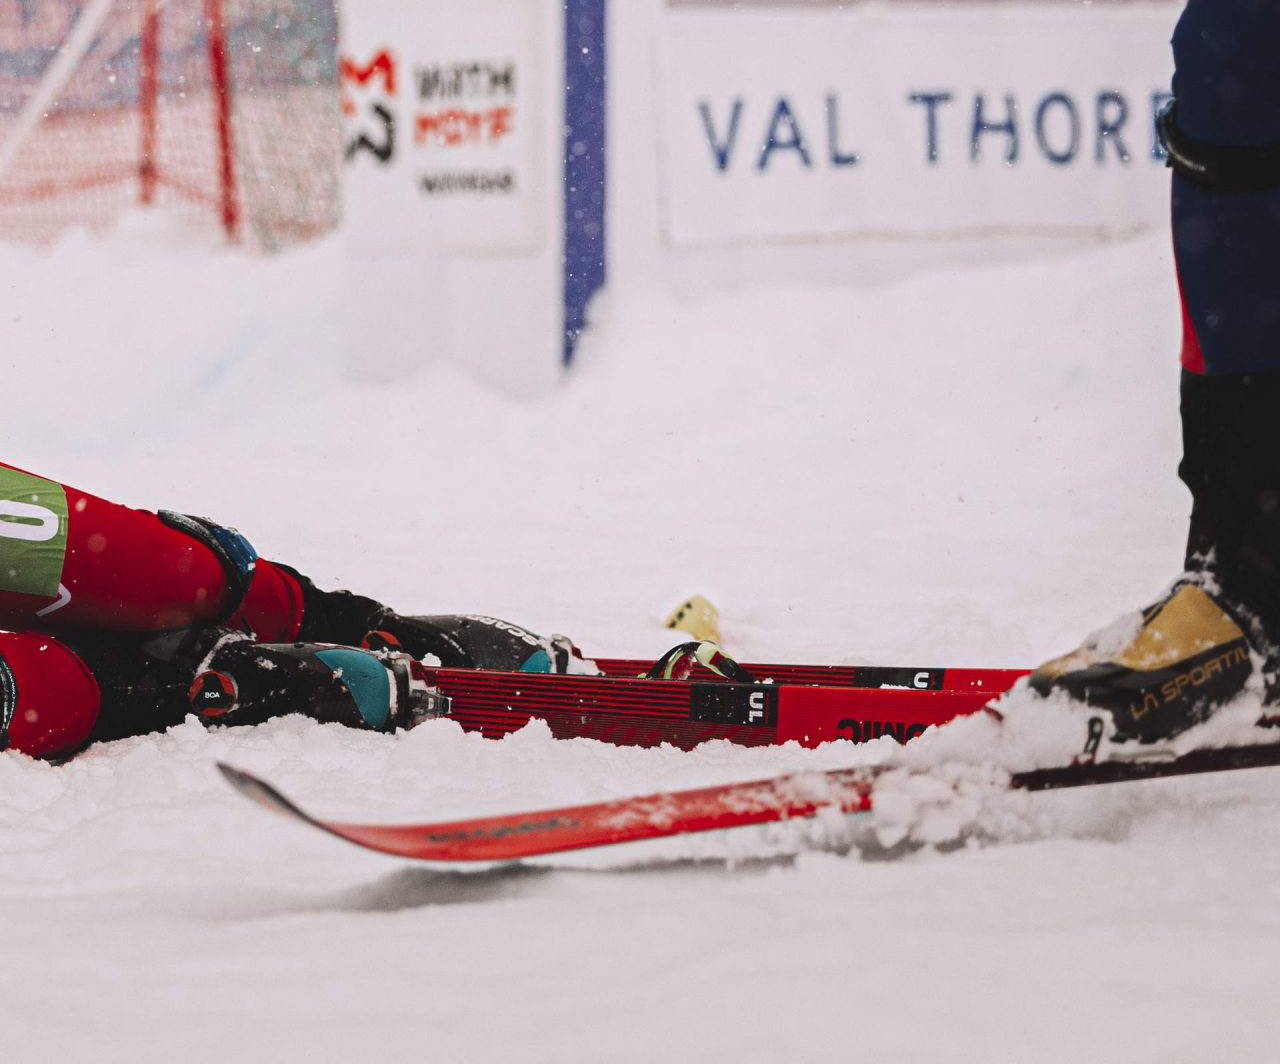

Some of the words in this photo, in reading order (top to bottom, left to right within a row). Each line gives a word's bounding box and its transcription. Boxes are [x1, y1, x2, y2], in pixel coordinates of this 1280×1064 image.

[698, 93, 860, 172] VAL
[204, 691, 220, 699] BOA
[1129, 694, 1159, 720] LA
[1161, 647, 1250, 702] SPORTI
